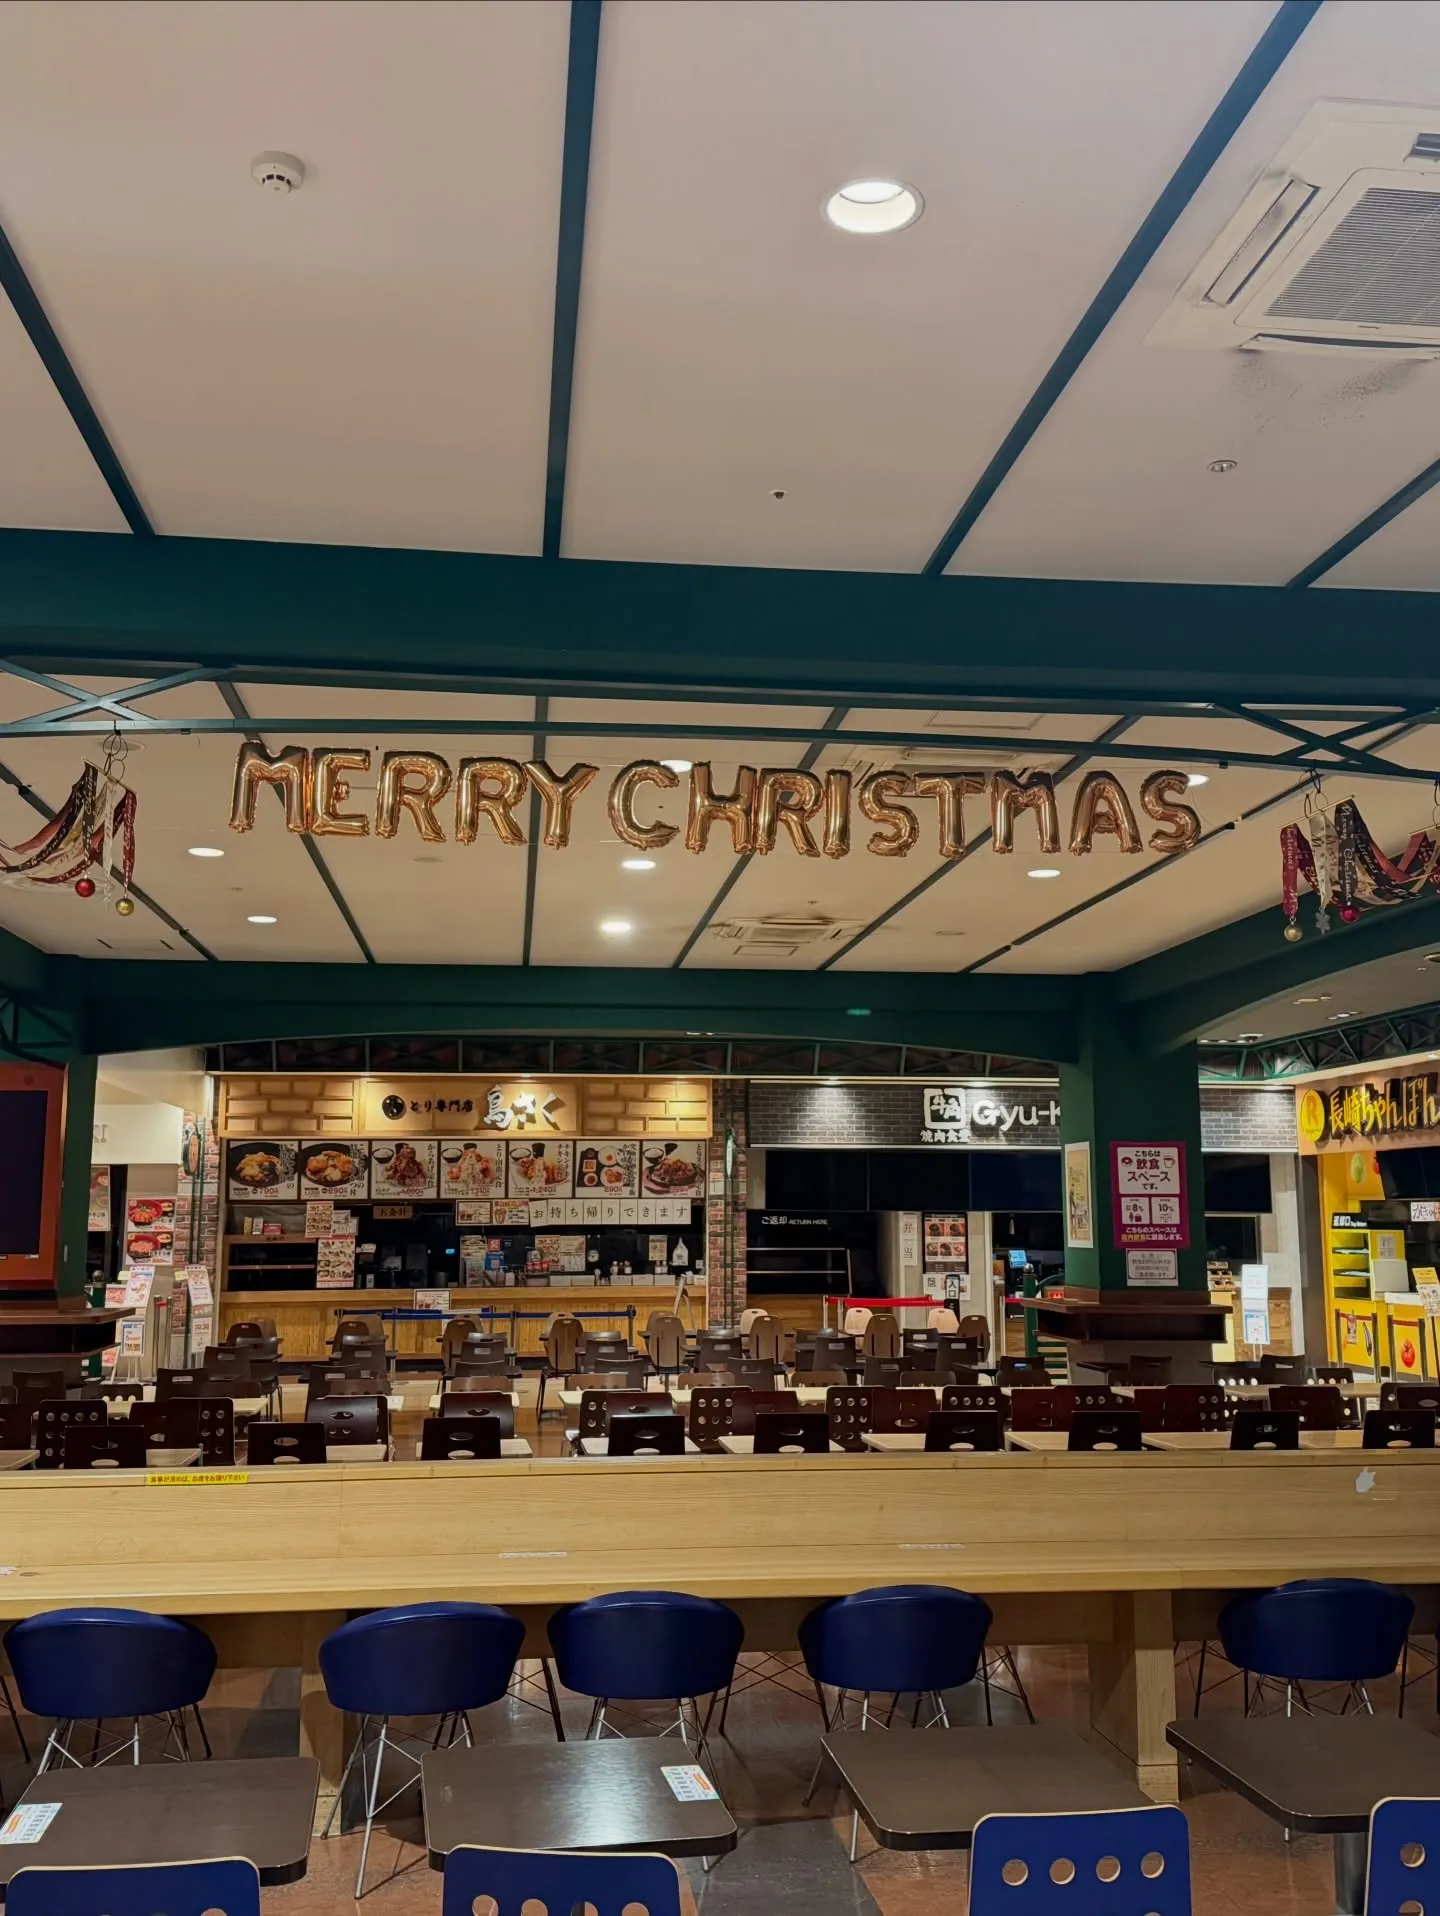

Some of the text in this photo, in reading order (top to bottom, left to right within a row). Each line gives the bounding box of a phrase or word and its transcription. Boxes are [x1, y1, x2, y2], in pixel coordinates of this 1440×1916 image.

[228, 741, 1202, 859] MERRY CHRISTMAS
[409, 1099, 474, 1113] とり専門店
[920, 1129, 971, 1143] 焼肉食堂
[1136, 1158, 1160, 1170] 飲食
[1127, 1171, 1171, 1182] スペース
[533, 1206, 688, 1219] お持ち帰りできます
[761, 1216, 788, 1225] ご返却
[948, 1280, 957, 1298] 入口
